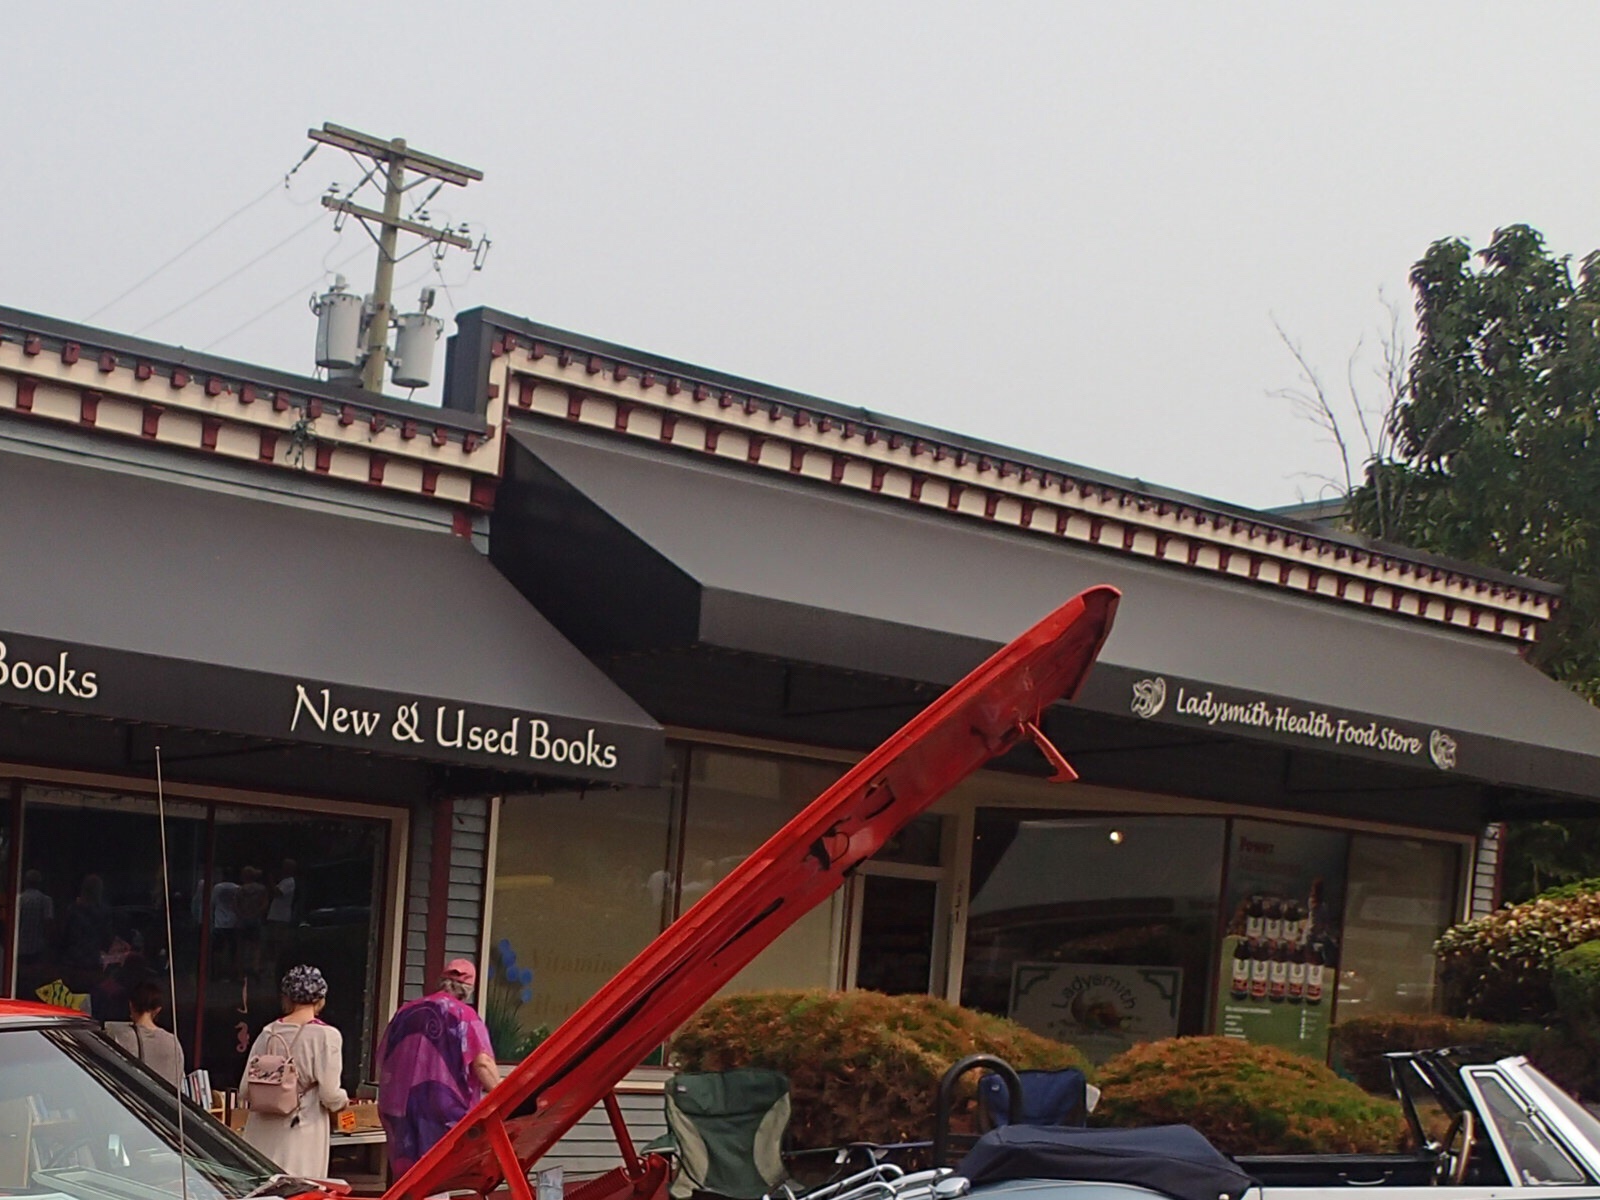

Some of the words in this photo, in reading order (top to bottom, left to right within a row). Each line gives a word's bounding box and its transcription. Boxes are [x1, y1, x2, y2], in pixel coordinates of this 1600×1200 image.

[290, 683, 380, 737] New
[391, 700, 425, 744] &
[435, 705, 520, 756] Used
[529, 719, 618, 769] Books
[1176, 687, 1274, 726] Ladysmith
[1274, 706, 1336, 739] Health
[1335, 719, 1379, 746] Food
[1378, 727, 1422, 755] Store
